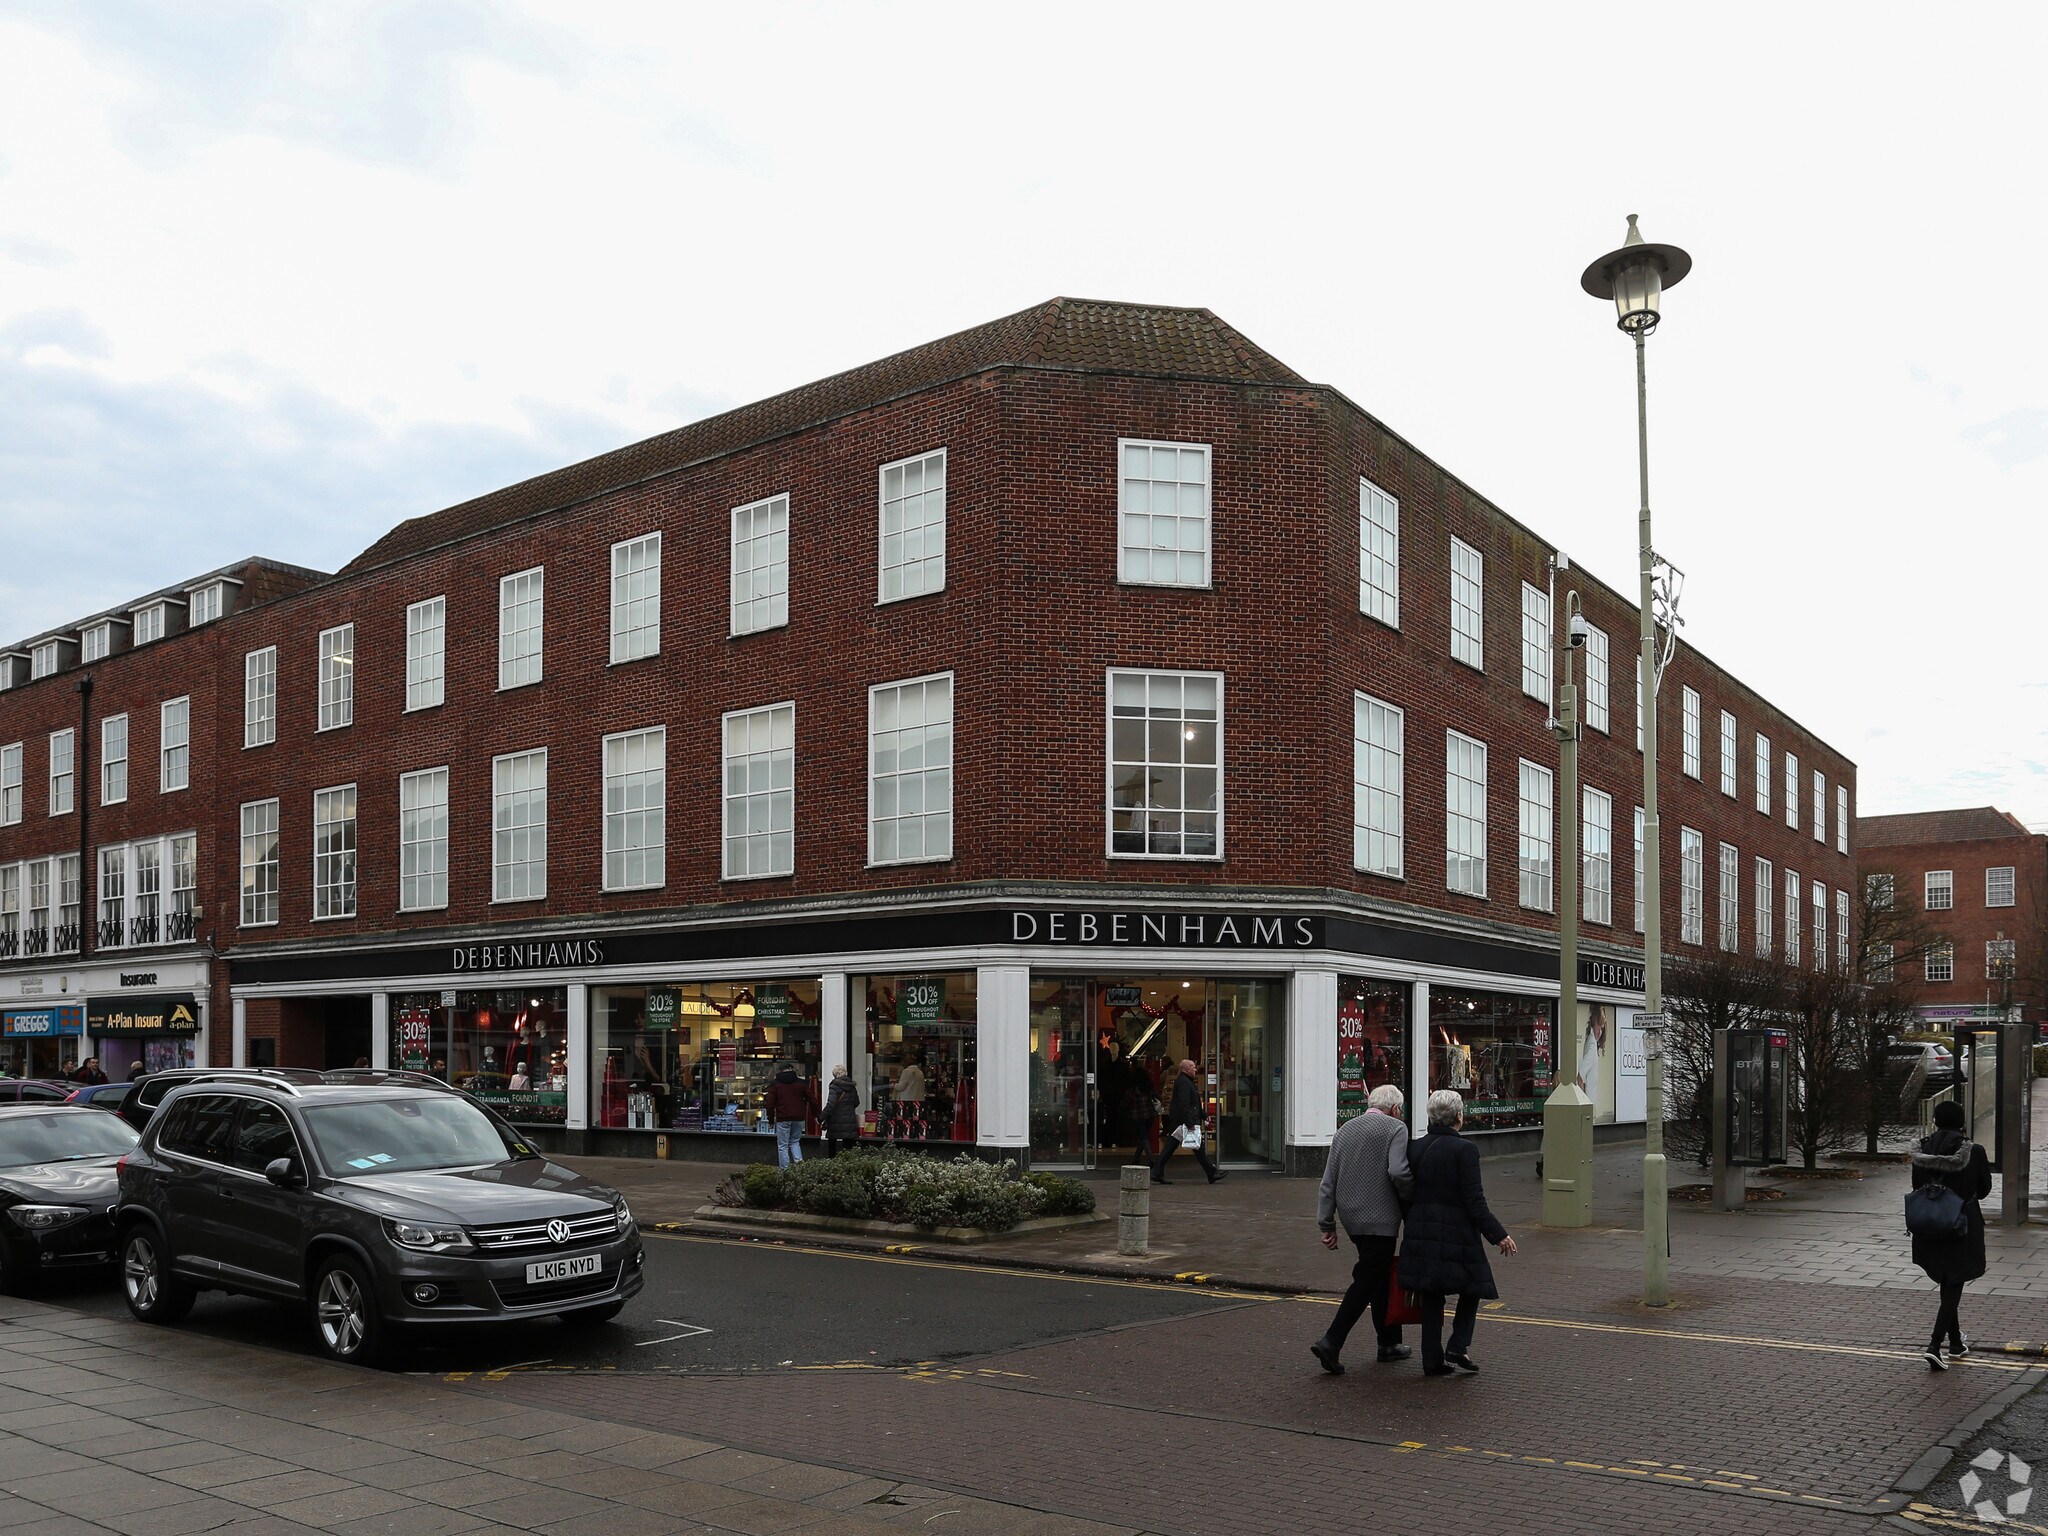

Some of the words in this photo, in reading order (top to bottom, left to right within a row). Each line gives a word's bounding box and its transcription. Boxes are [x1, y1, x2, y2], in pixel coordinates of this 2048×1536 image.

[1012, 912, 1314, 946] DEBENHAMS
[453, 940, 598, 970] DEBENHAMS
[120, 973, 157, 987] Insurance
[1593, 962, 1645, 988] DEBENHA
[650, 995, 674, 1012] 30%
[907, 986, 938, 1006] 30%
[14, 1014, 50, 1033] GREGGS
[107, 1012, 132, 1029] A-Plan
[169, 1021, 195, 1030] a-plan
[403, 1022, 427, 1040] 30%
[1623, 1054, 1646, 1069] COLLEC
[478, 1096, 510, 1104] TRAVAGANZA
[535, 1262, 566, 1280] LK16
[570, 1257, 594, 1275] NYD
